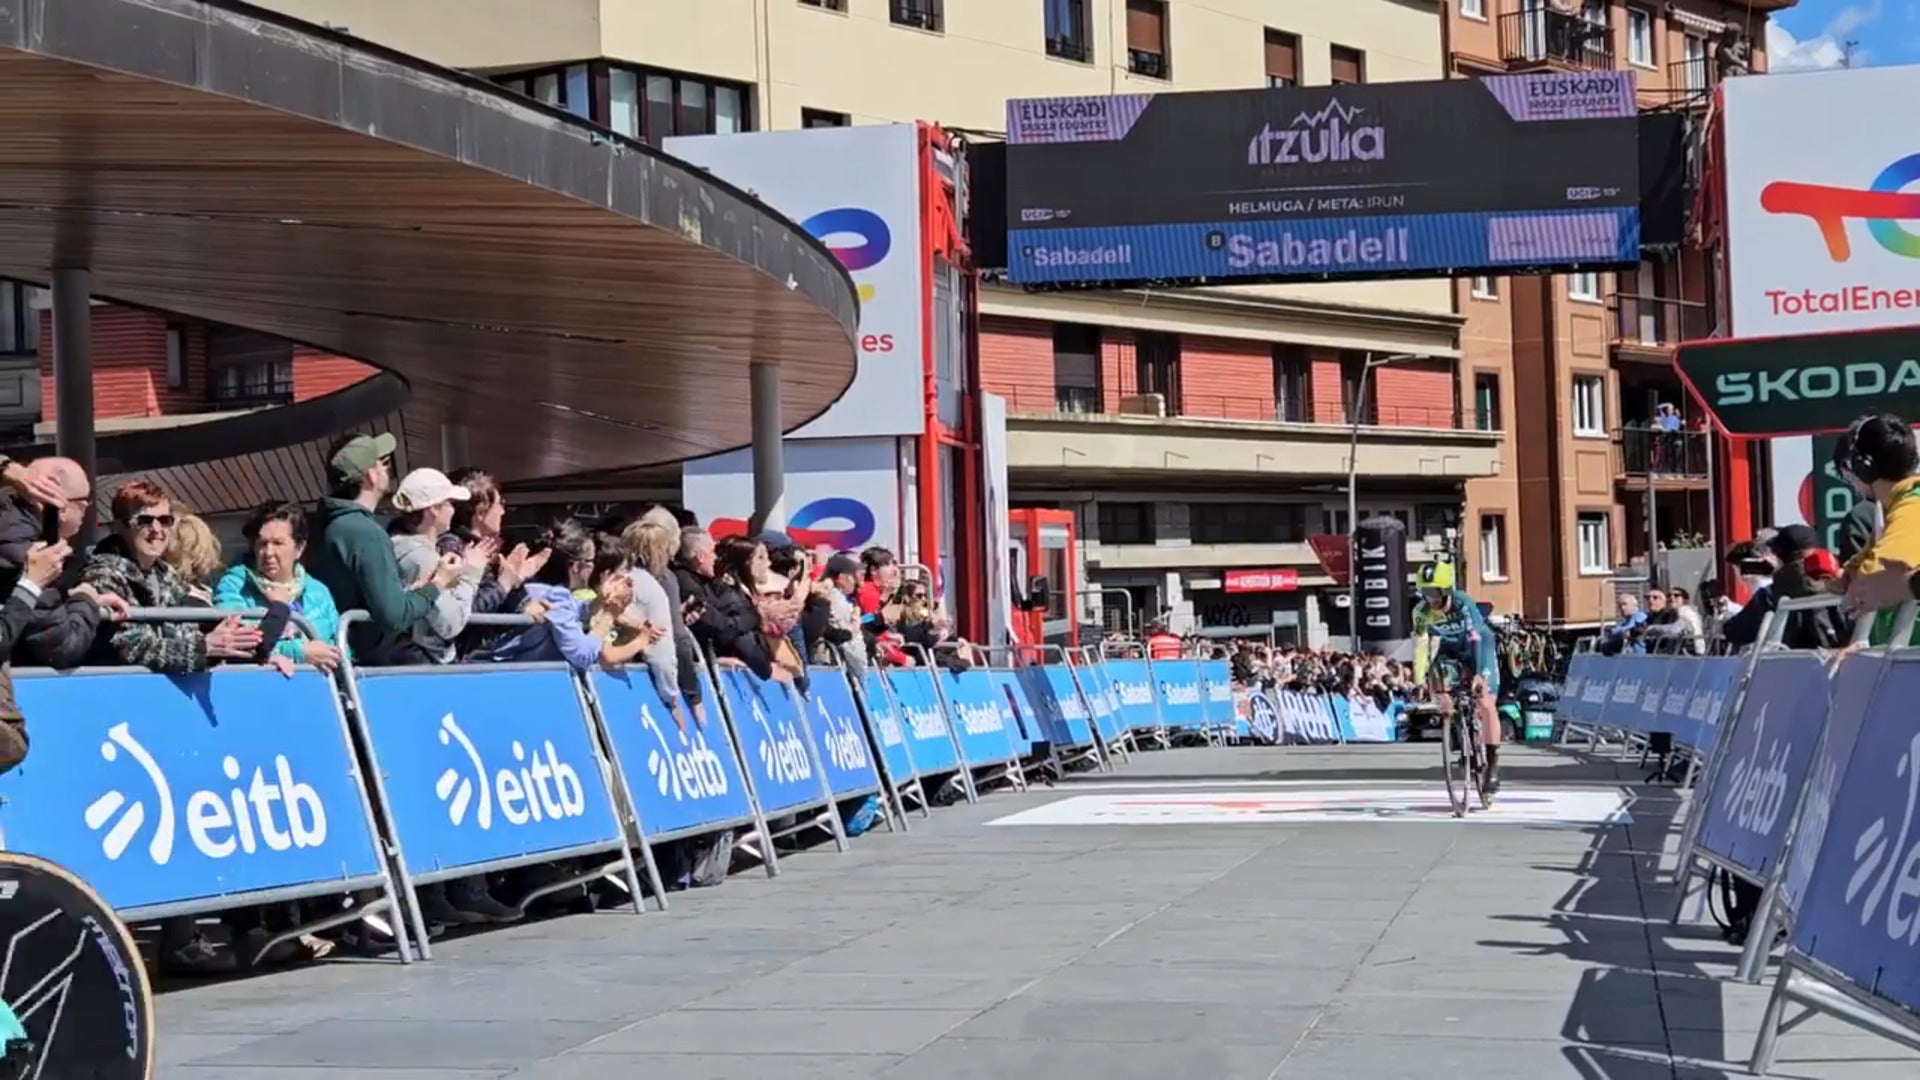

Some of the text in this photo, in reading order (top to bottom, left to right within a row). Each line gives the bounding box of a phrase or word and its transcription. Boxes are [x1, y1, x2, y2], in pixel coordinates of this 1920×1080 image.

[1021, 101, 1106, 120] EUSKADI
[1528, 78, 1619, 97] EUSKADI
[1229, 195, 1404, 214] HELMUGA / META: IRUN
[1034, 244, 1131, 267] Sabadell
[1228, 227, 1408, 268] Sabadell
[1361, 545, 1391, 626] GOBIK
[496, 739, 584, 825] eitb
[676, 731, 728, 799] eitb
[777, 720, 811, 783] eitb
[186, 754, 328, 858] eitb
[1738, 738, 1792, 836] eitb
